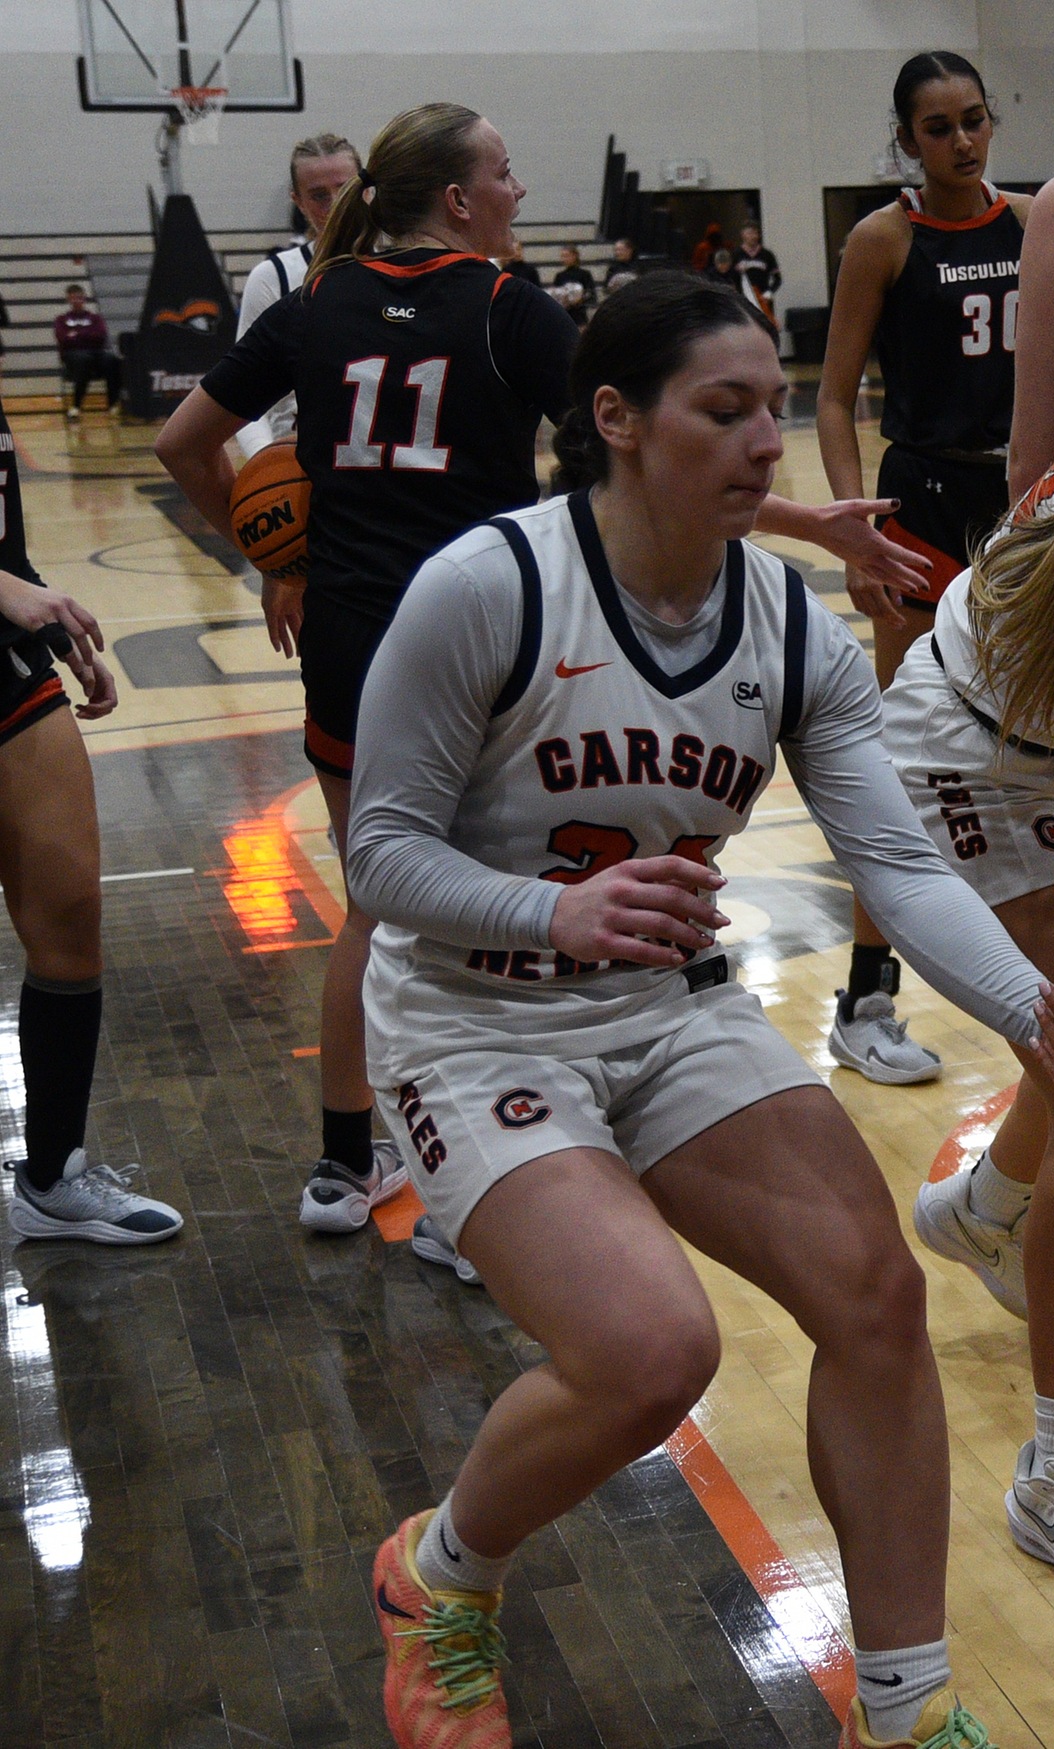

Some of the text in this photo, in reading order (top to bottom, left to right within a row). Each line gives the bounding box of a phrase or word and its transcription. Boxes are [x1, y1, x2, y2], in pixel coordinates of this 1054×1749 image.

[386, 306, 416, 319] SAC
[332, 354, 453, 472] 11
[534, 728, 764, 815] CARSON
